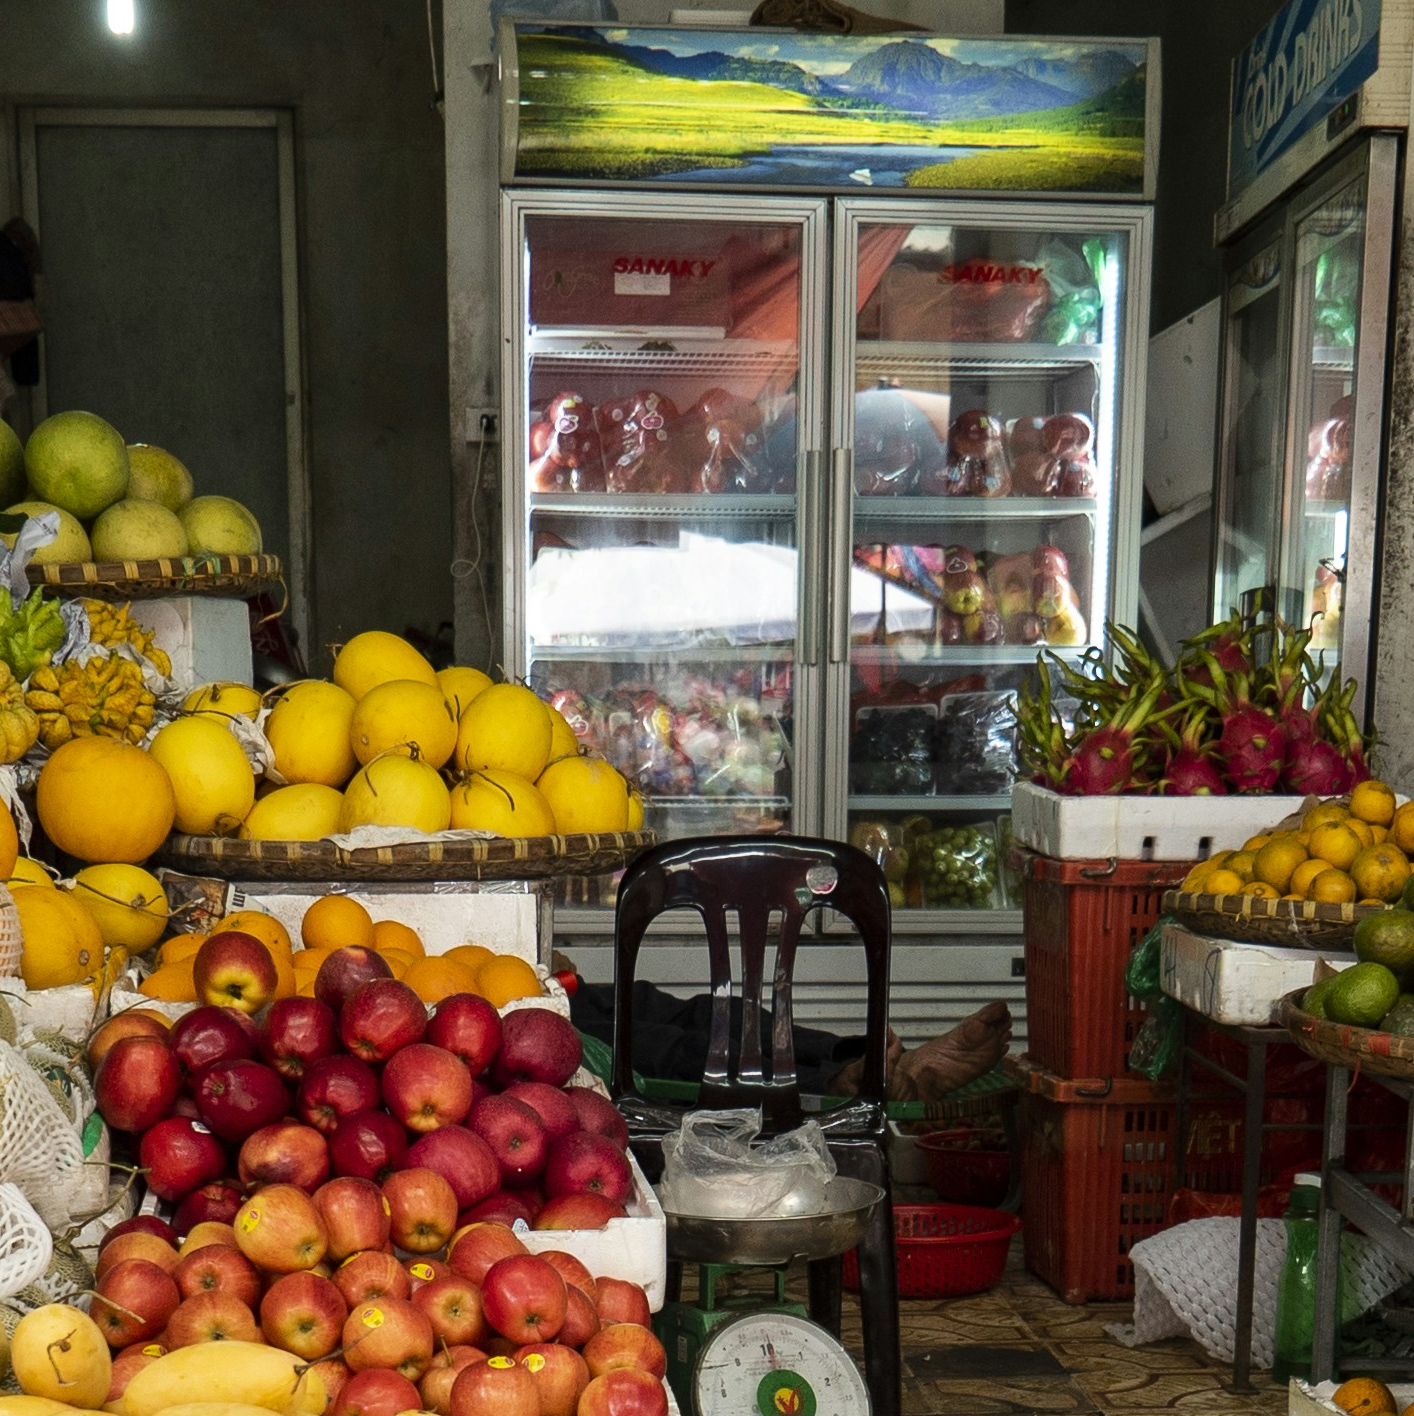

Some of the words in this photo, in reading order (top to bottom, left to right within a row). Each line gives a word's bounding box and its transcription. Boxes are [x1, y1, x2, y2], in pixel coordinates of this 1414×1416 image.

[1243, 52, 1287, 149] COLD
[613, 256, 716, 278] SANAKY
[939, 264, 1045, 285] SANAKY
